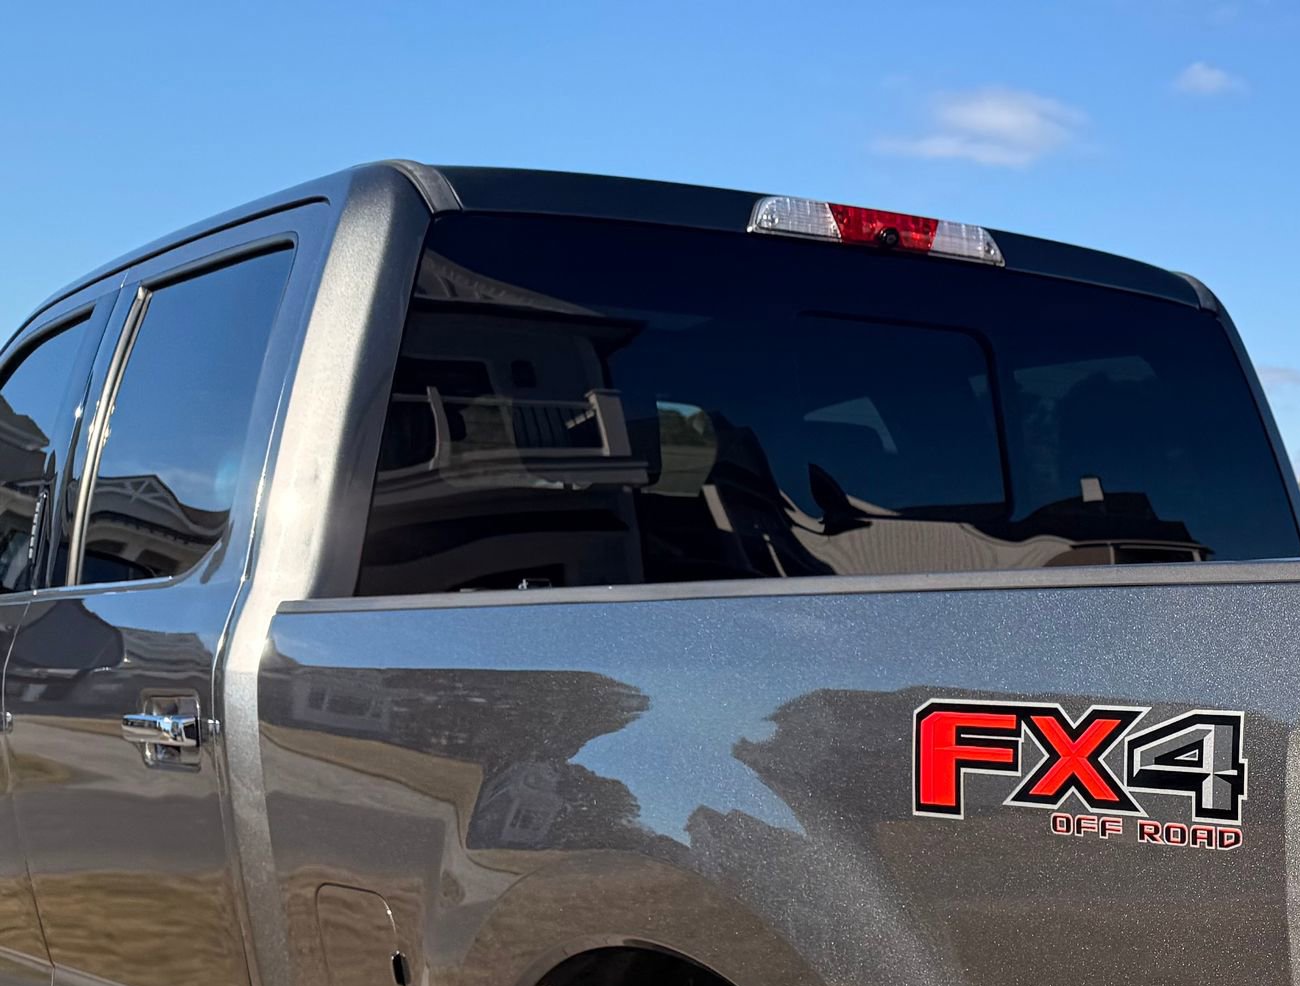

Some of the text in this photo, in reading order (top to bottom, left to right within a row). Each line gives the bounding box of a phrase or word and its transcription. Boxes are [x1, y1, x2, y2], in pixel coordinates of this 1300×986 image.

[913, 697, 1248, 825] FX4
[1051, 812, 1243, 850] OFF ROAD
